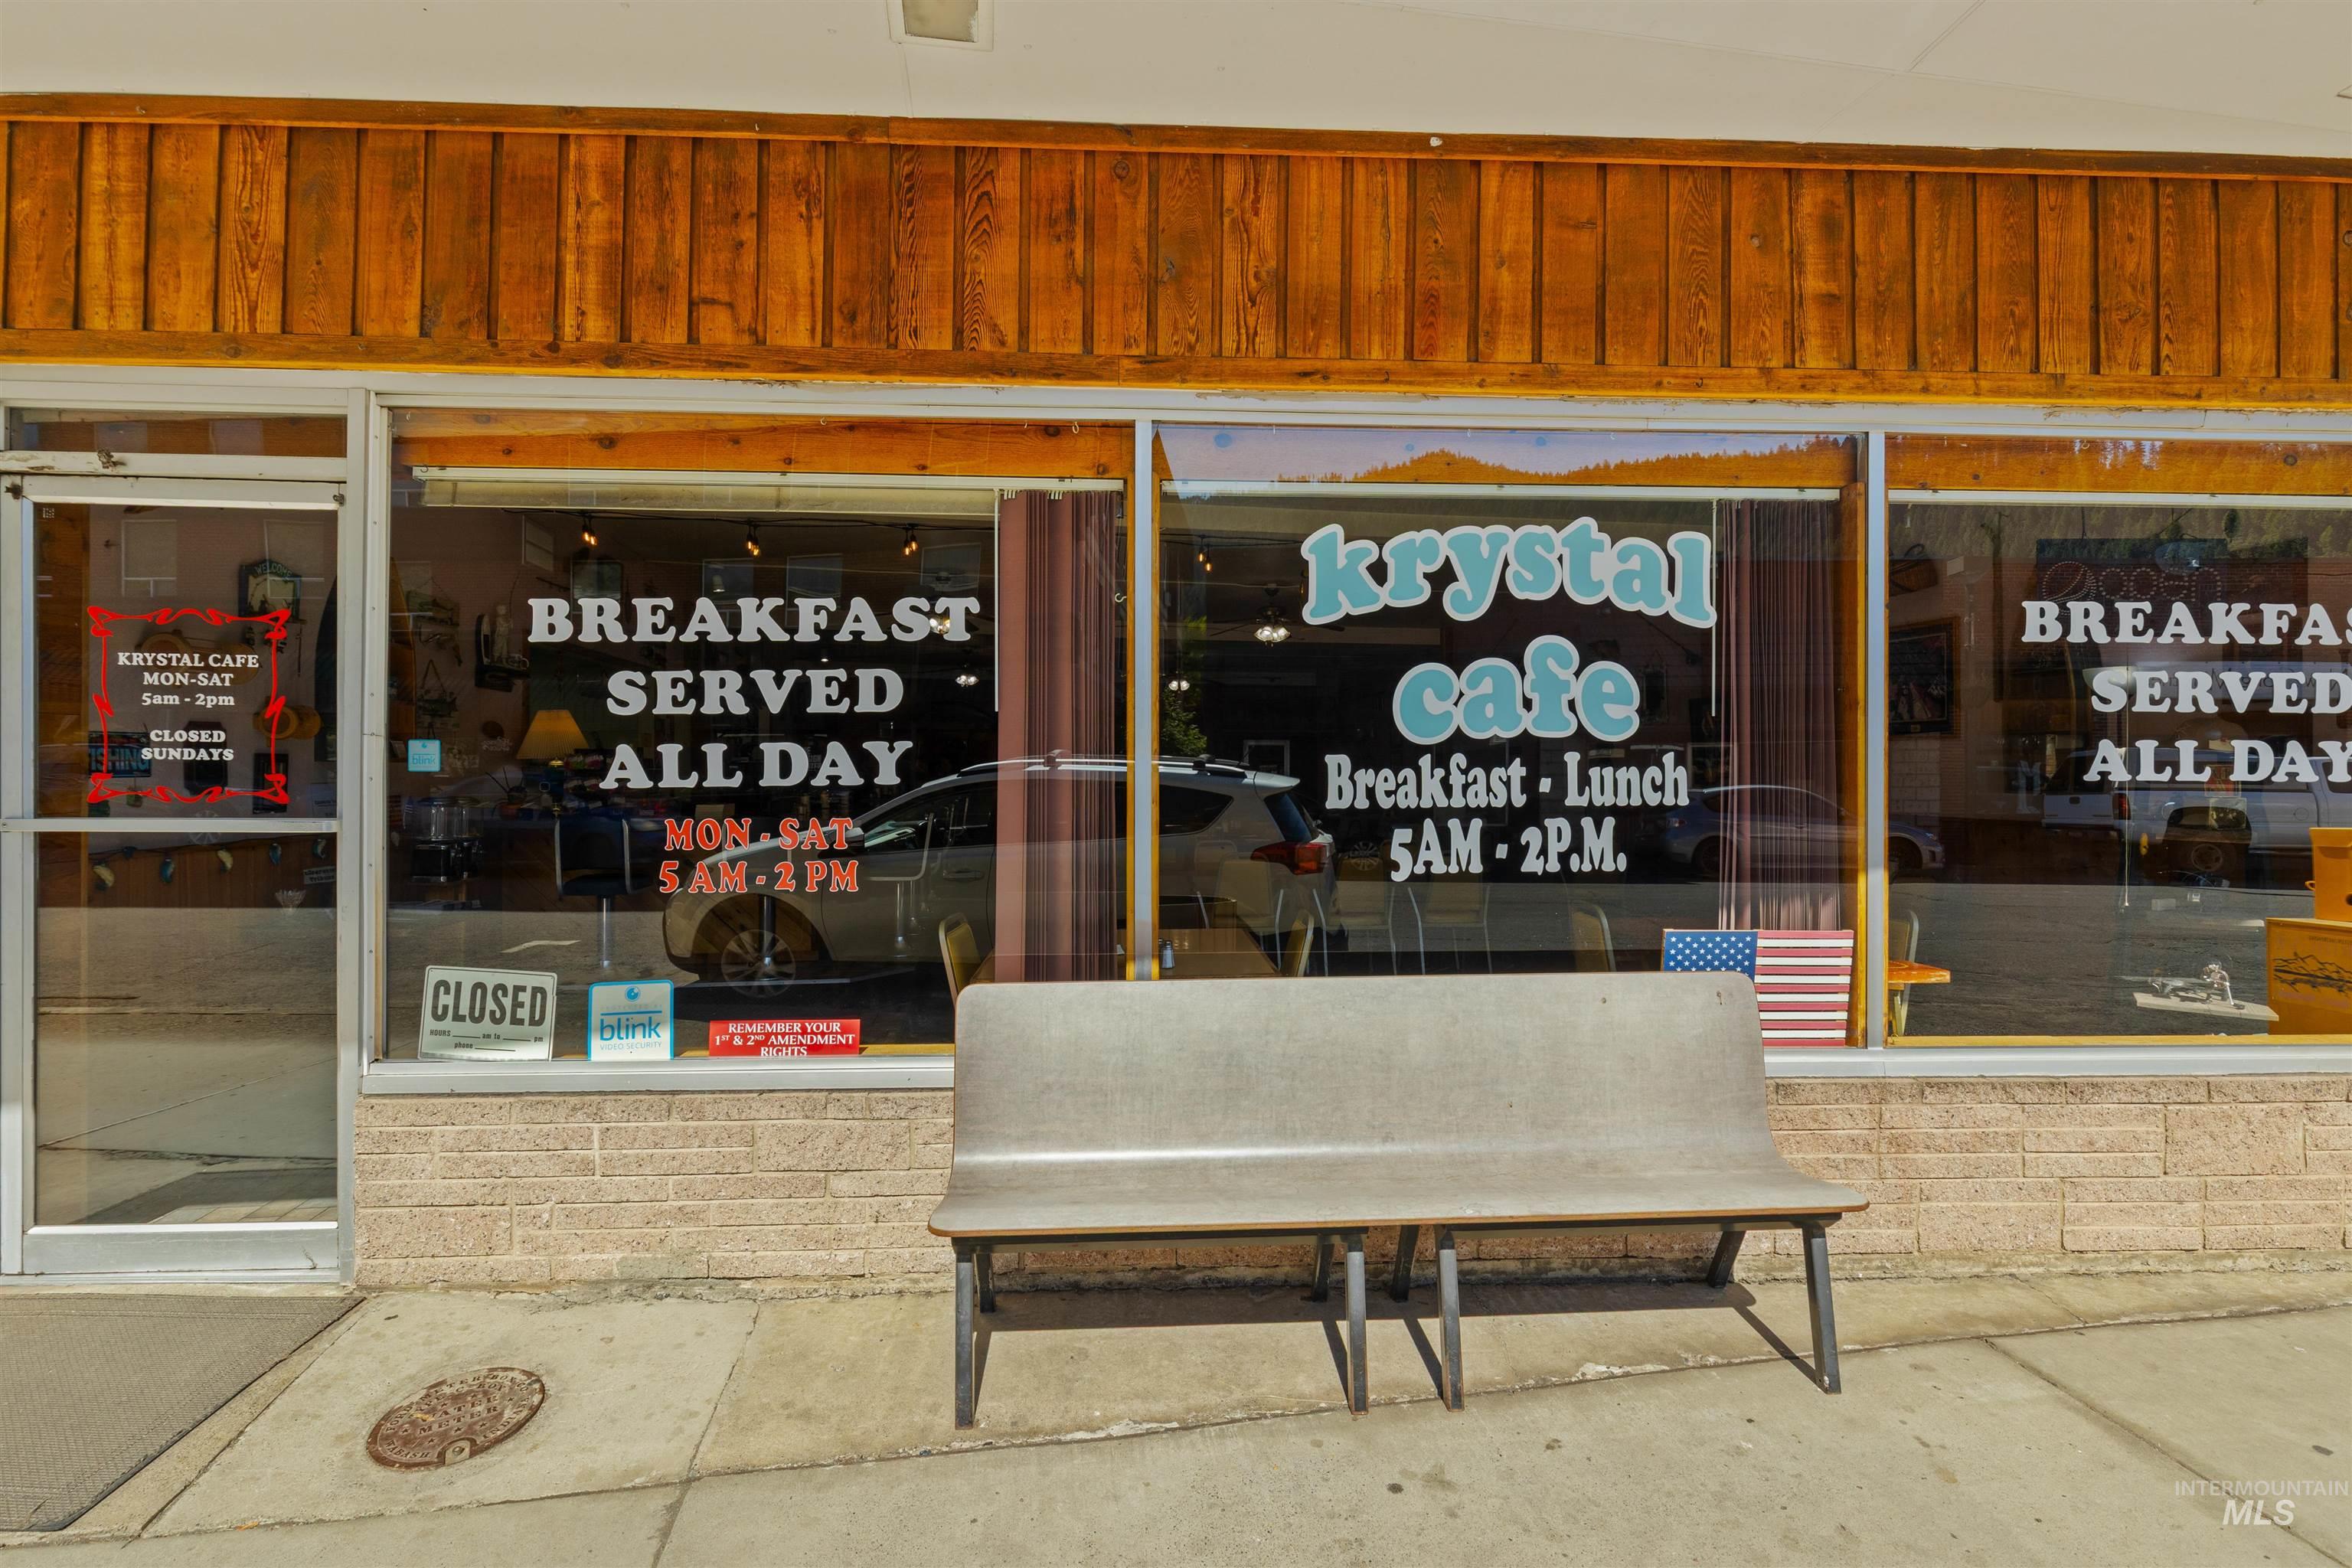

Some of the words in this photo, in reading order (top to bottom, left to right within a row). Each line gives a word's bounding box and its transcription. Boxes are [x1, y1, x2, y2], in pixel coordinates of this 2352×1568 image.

[254, 563, 293, 577] WELCOME
[1301, 516, 1717, 629] krystal
[528, 596, 981, 642] BREAKFAST
[2021, 601, 2352, 645] BREAKFA
[117, 652, 204, 667] KRYSTAL
[208, 655, 259, 668] CAFE
[142, 671, 234, 686] MON-SAT
[606, 668, 903, 716] SERVED
[1393, 635, 1640, 745] cafe
[2091, 671, 2352, 714] SERVED
[141, 693, 180, 705] 5am
[194, 694, 235, 707] 2pm
[149, 730, 226, 743] CLOSED
[141, 748, 234, 760] SUNDAYS
[412, 755, 436, 766] blink
[599, 743, 743, 789] ALL
[759, 741, 913, 786] DAY
[2083, 739, 2211, 782] ALL
[2230, 740, 2352, 782] DAY
[1325, 753, 1527, 809] Breakfast
[1563, 752, 1689, 807] Lunch
[665, 818, 751, 851] MON
[779, 818, 853, 850] SAT
[1390, 818, 1483, 882] 5AM
[1521, 816, 1627, 875] 2P.M.
[658, 862, 679, 893] 5
[688, 861, 748, 893] AM
[774, 862, 796, 892] 2
[805, 860, 859, 893] PM
[431, 979, 547, 1027] CLOSED
[430, 1029, 452, 1038] HOURS
[600, 1017, 662, 1041] blink
[728, 1022, 802, 1034] REMEMBER
[805, 1022, 841, 1032] YOUR
[733, 1036, 743, 1046] &
[768, 1034, 855, 1045] AMENDMENT
[599, 1043, 624, 1051] VIDEO
[626, 1041, 662, 1050] SECURITY
[760, 1046, 808, 1057] RIGHTS
[385, 1406, 413, 1432] FORD
[420, 1376, 481, 1401] METER
[490, 1374, 517, 1383] BOX
[419, 1406, 499, 1434] METER
